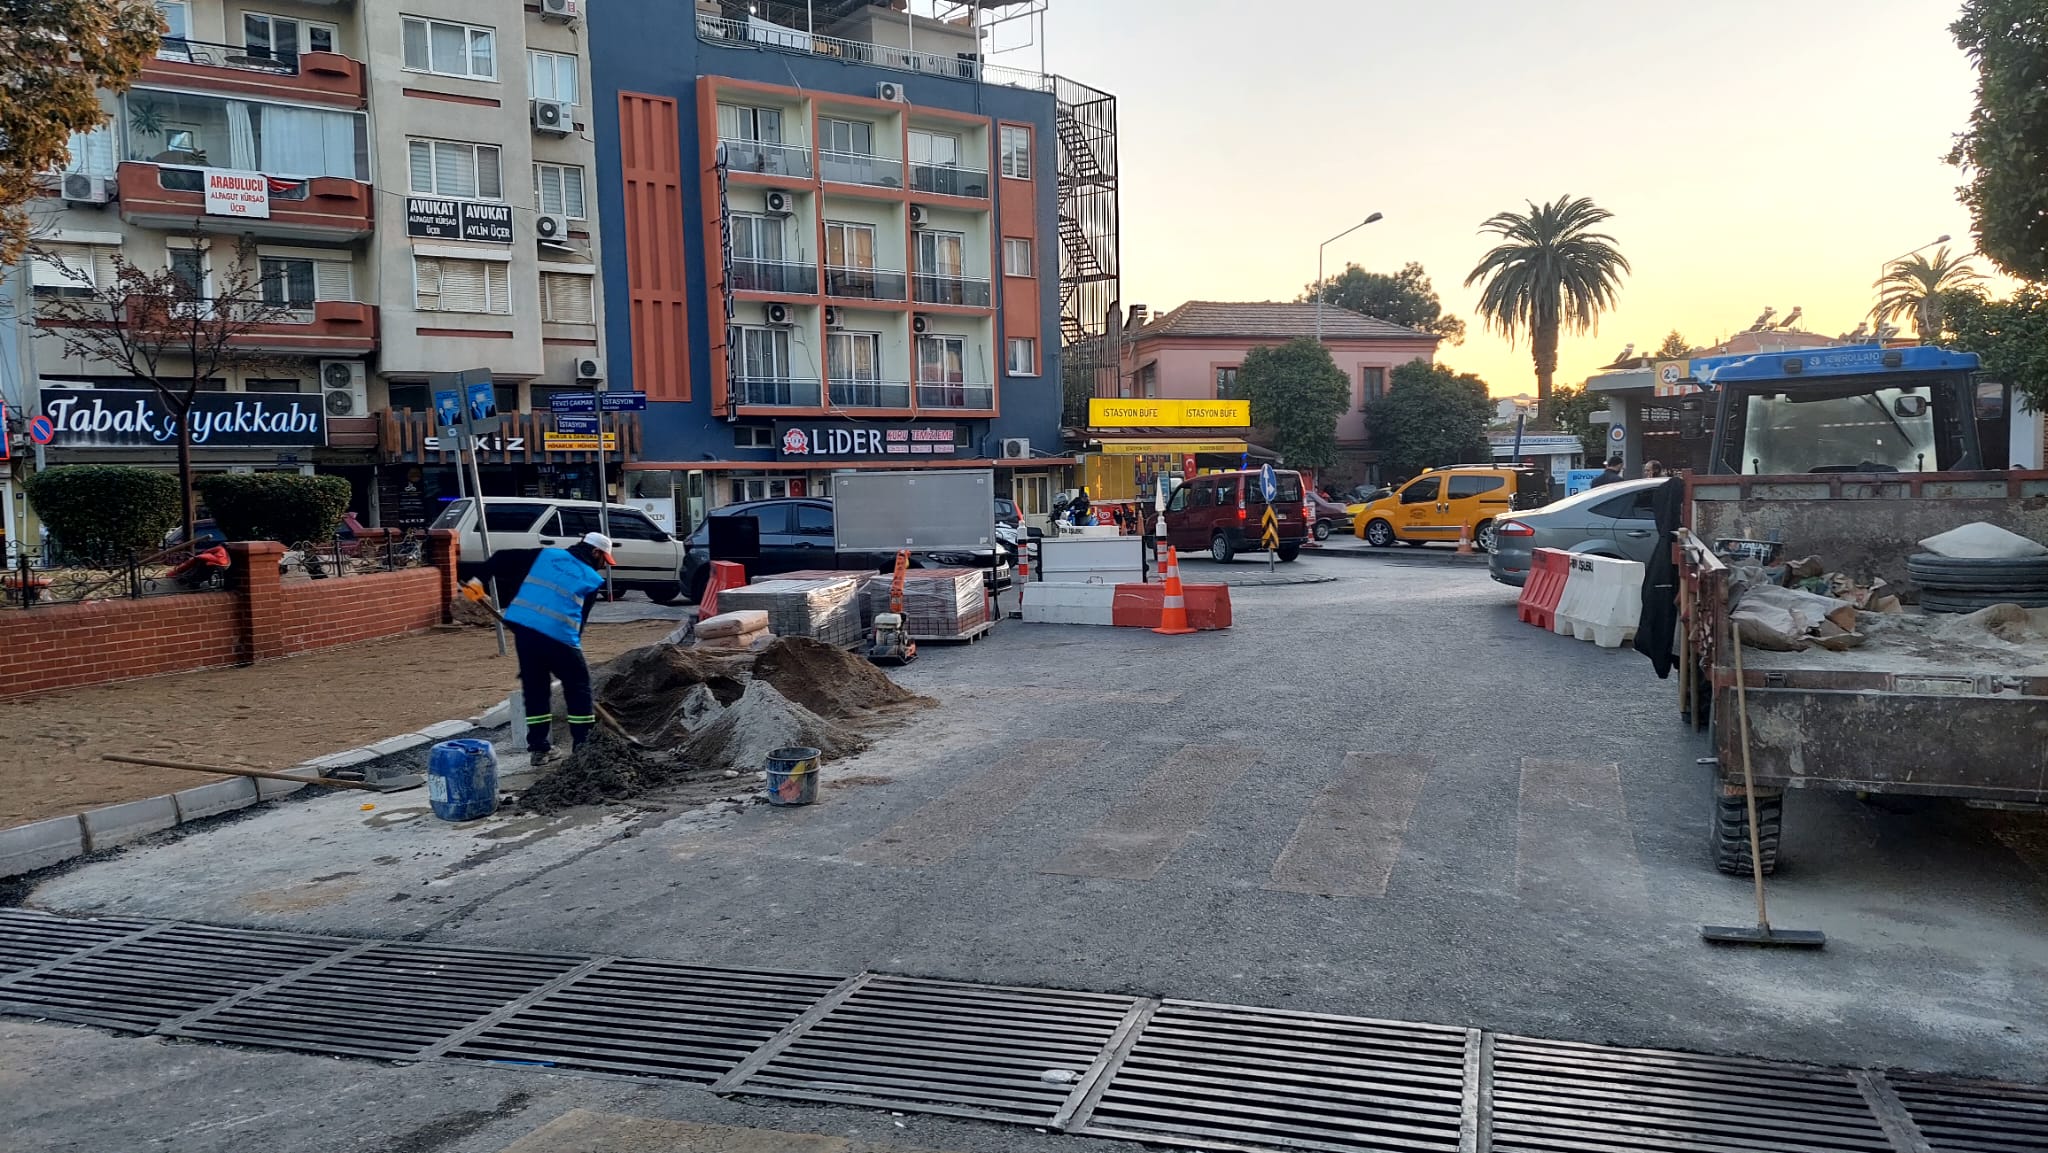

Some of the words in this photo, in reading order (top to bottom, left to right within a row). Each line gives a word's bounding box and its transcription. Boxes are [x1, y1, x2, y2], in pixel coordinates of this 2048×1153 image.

[210, 175, 264, 192] ARABULUCU
[410, 199, 455, 216] AVUKAT
[466, 204, 509, 221] AVUKAT
[466, 223, 489, 237] AYLİN
[490, 224, 511, 239] ÜÇER
[48, 396, 155, 432] Tabak
